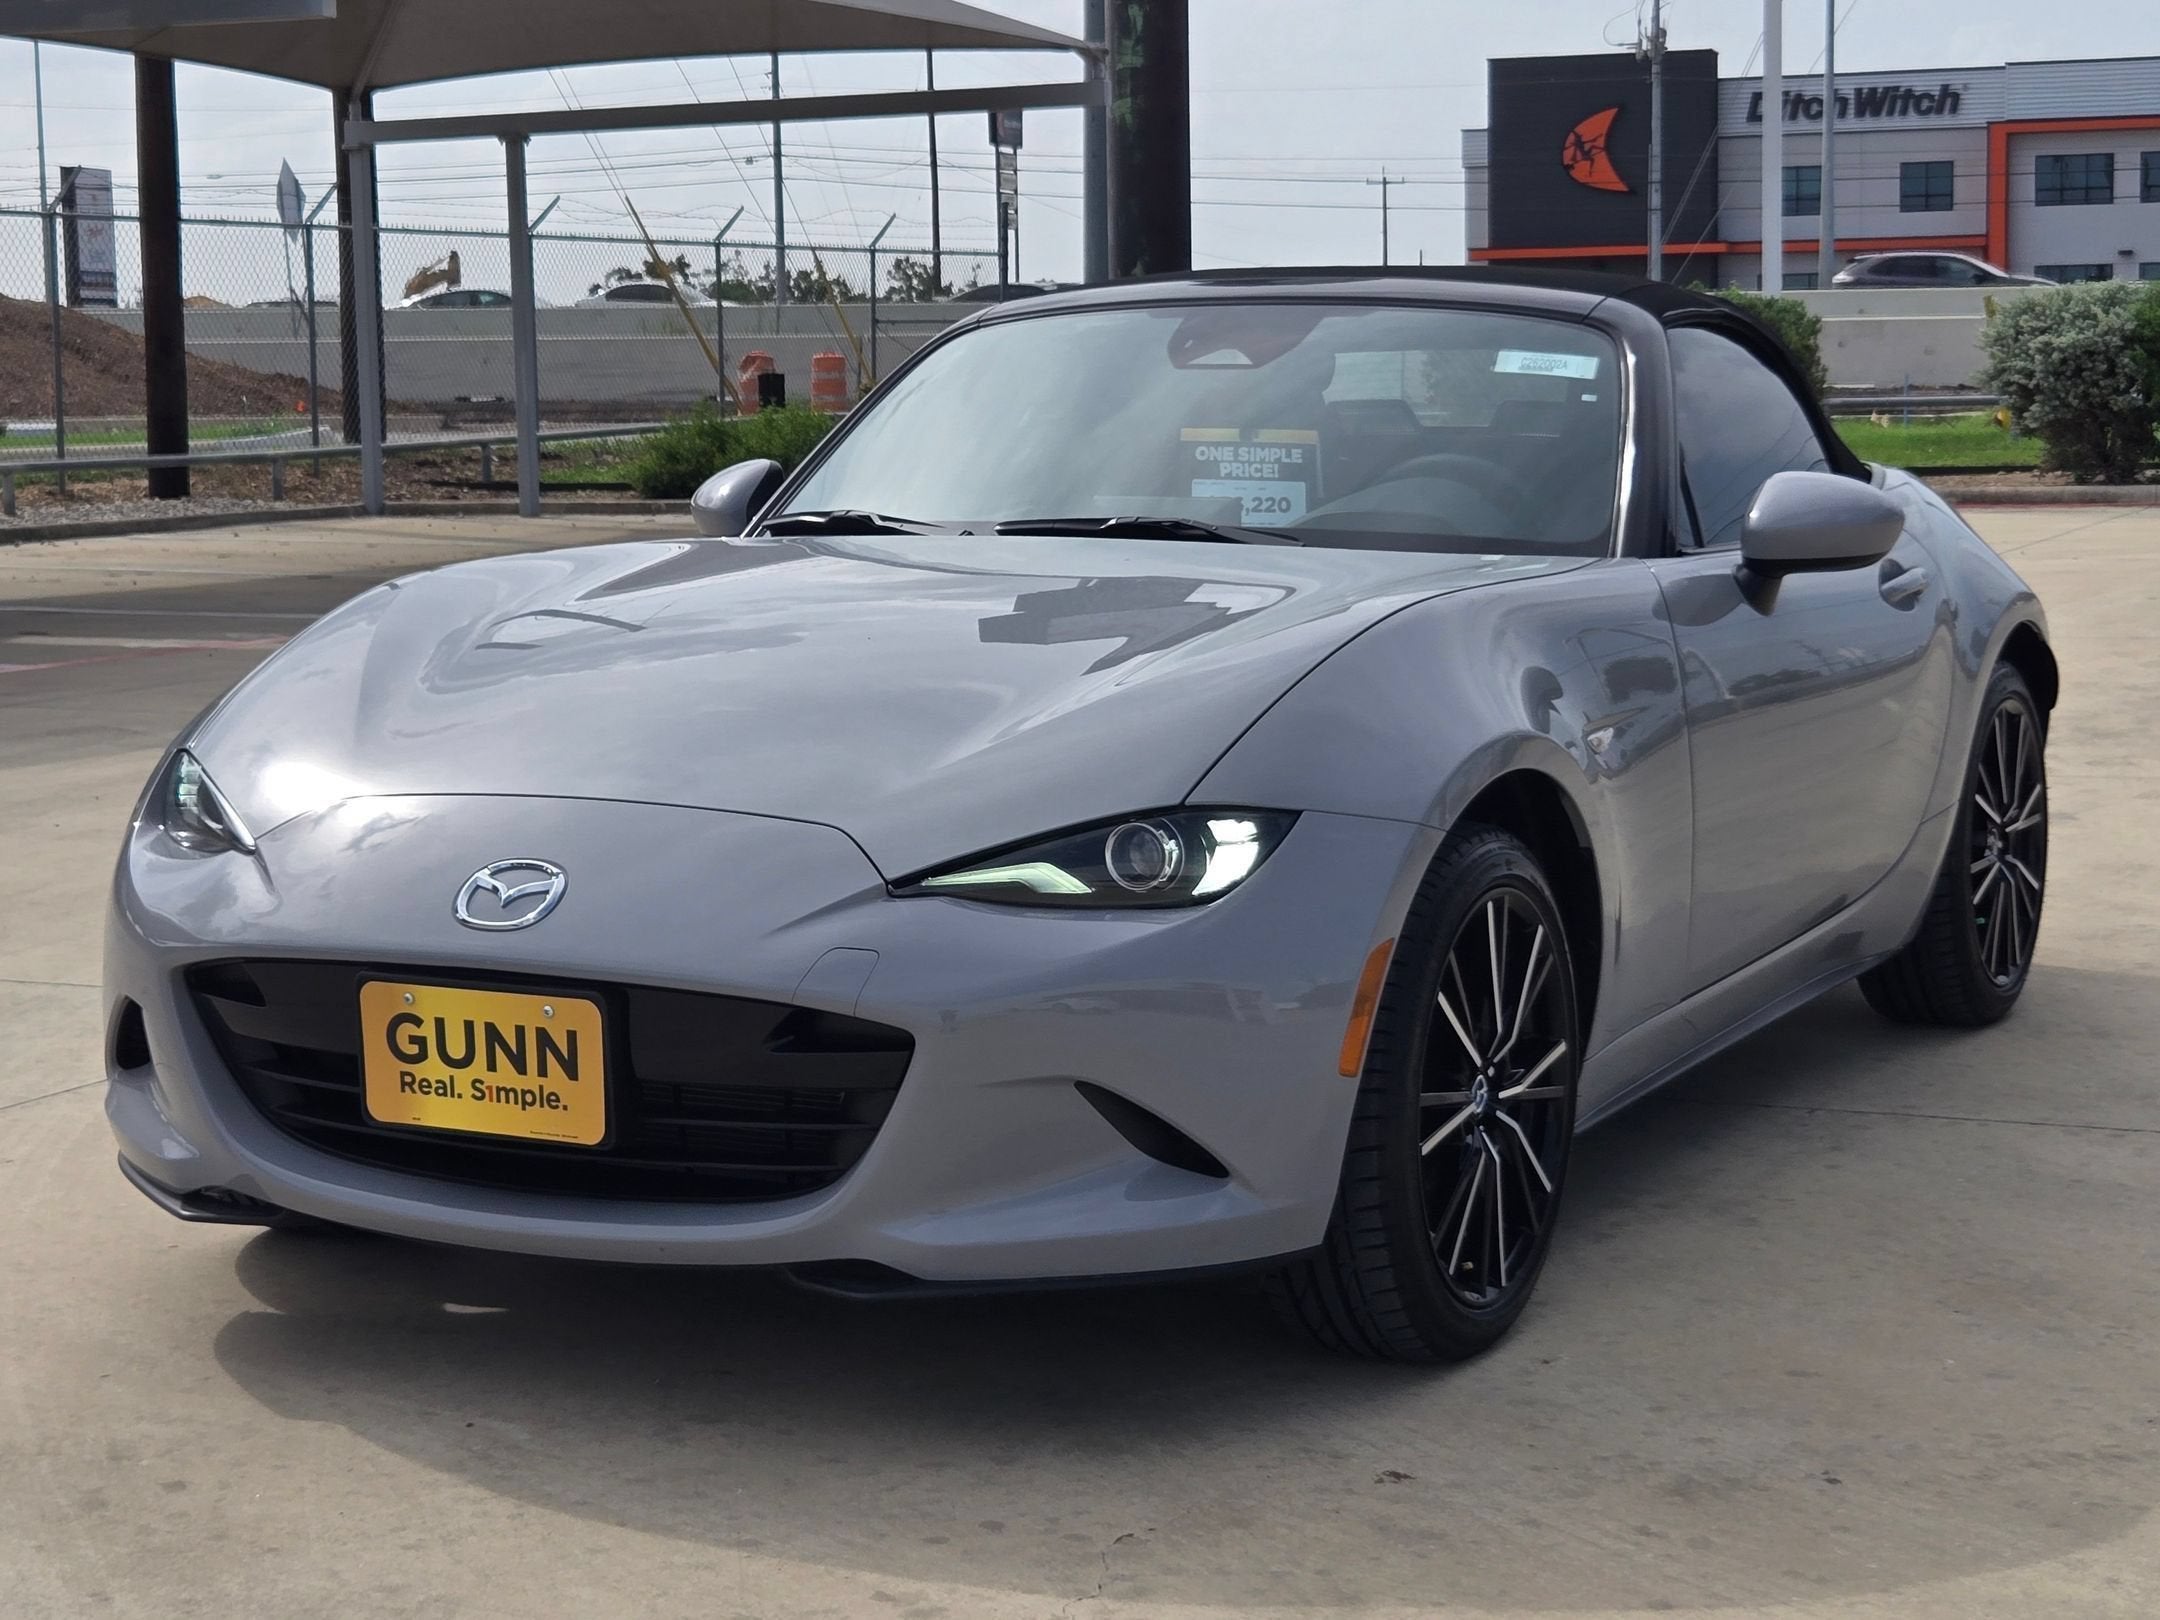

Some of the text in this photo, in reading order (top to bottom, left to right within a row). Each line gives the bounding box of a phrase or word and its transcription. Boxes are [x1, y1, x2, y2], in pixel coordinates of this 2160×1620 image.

[1854, 83, 1961, 117] Witch
[1195, 446, 1303, 463] ONE SIMPLE
[1219, 462, 1279, 478] PRICE!
[386, 1012, 579, 1081] GUNN
[400, 1071, 463, 1099] Real.
